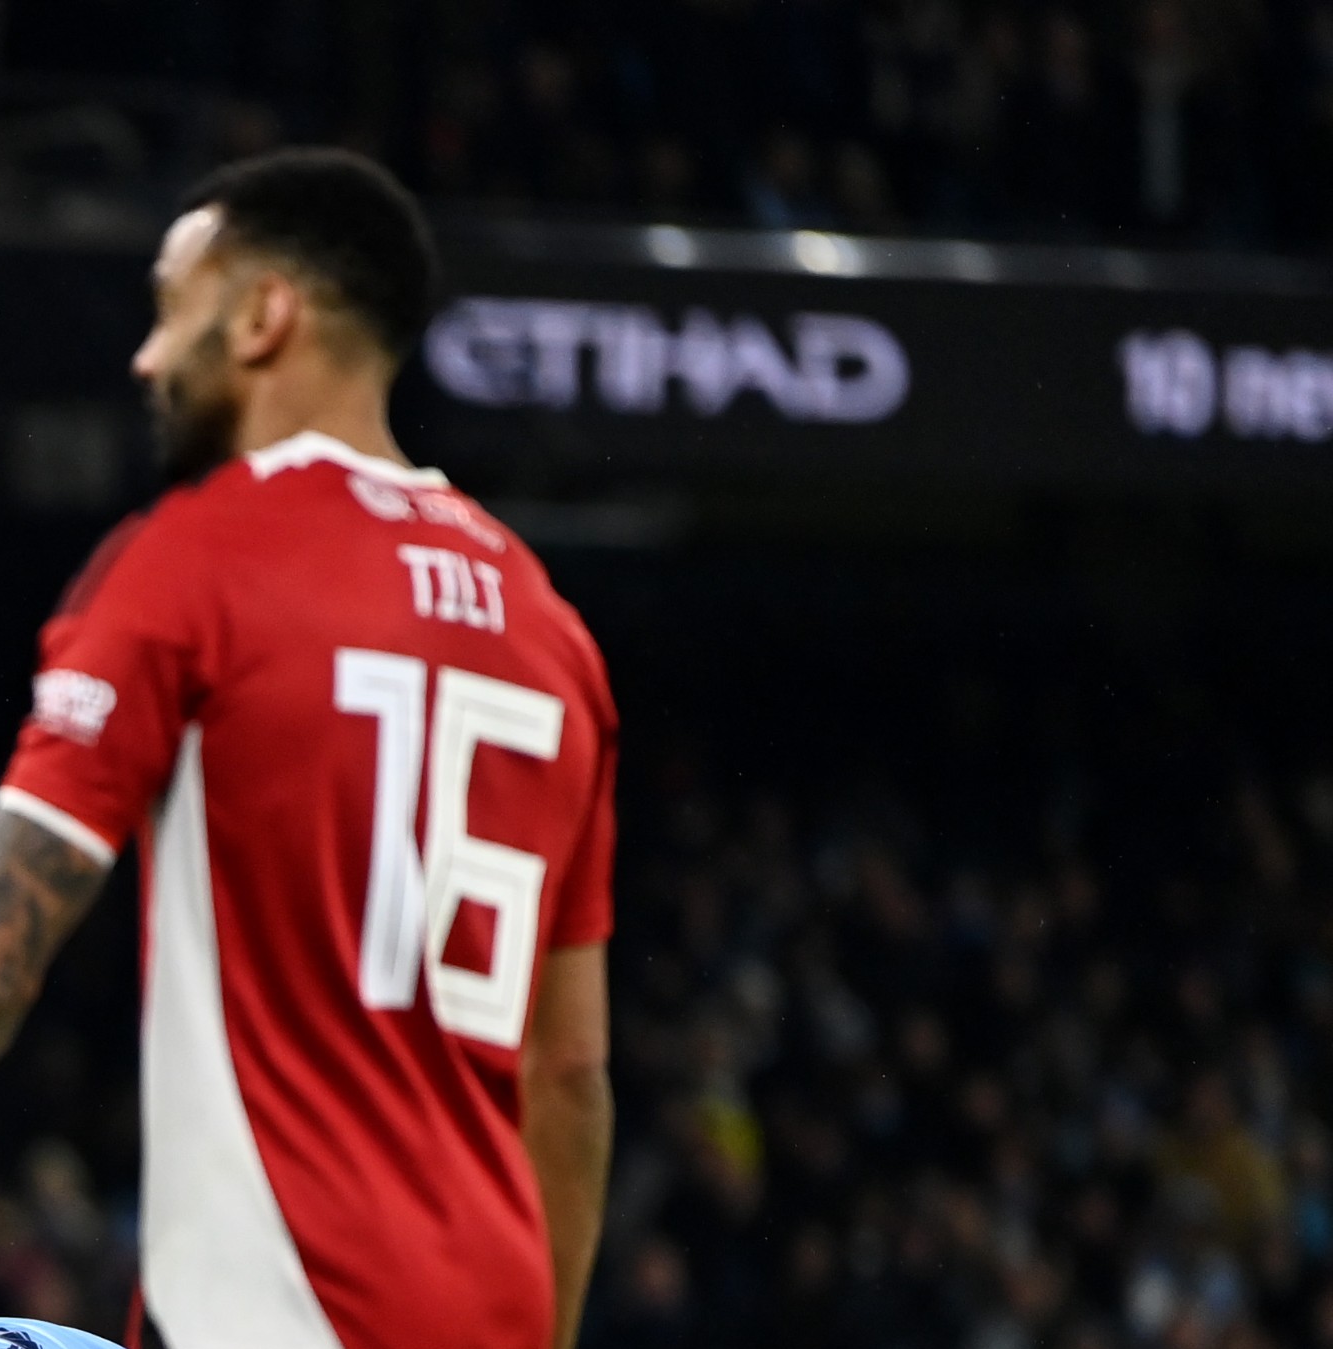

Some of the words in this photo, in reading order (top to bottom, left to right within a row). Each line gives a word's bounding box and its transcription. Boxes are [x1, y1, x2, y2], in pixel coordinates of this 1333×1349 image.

[422, 297, 912, 425] ETIHAD
[396, 542, 506, 635] TILT
[334, 646, 565, 1049] 16
